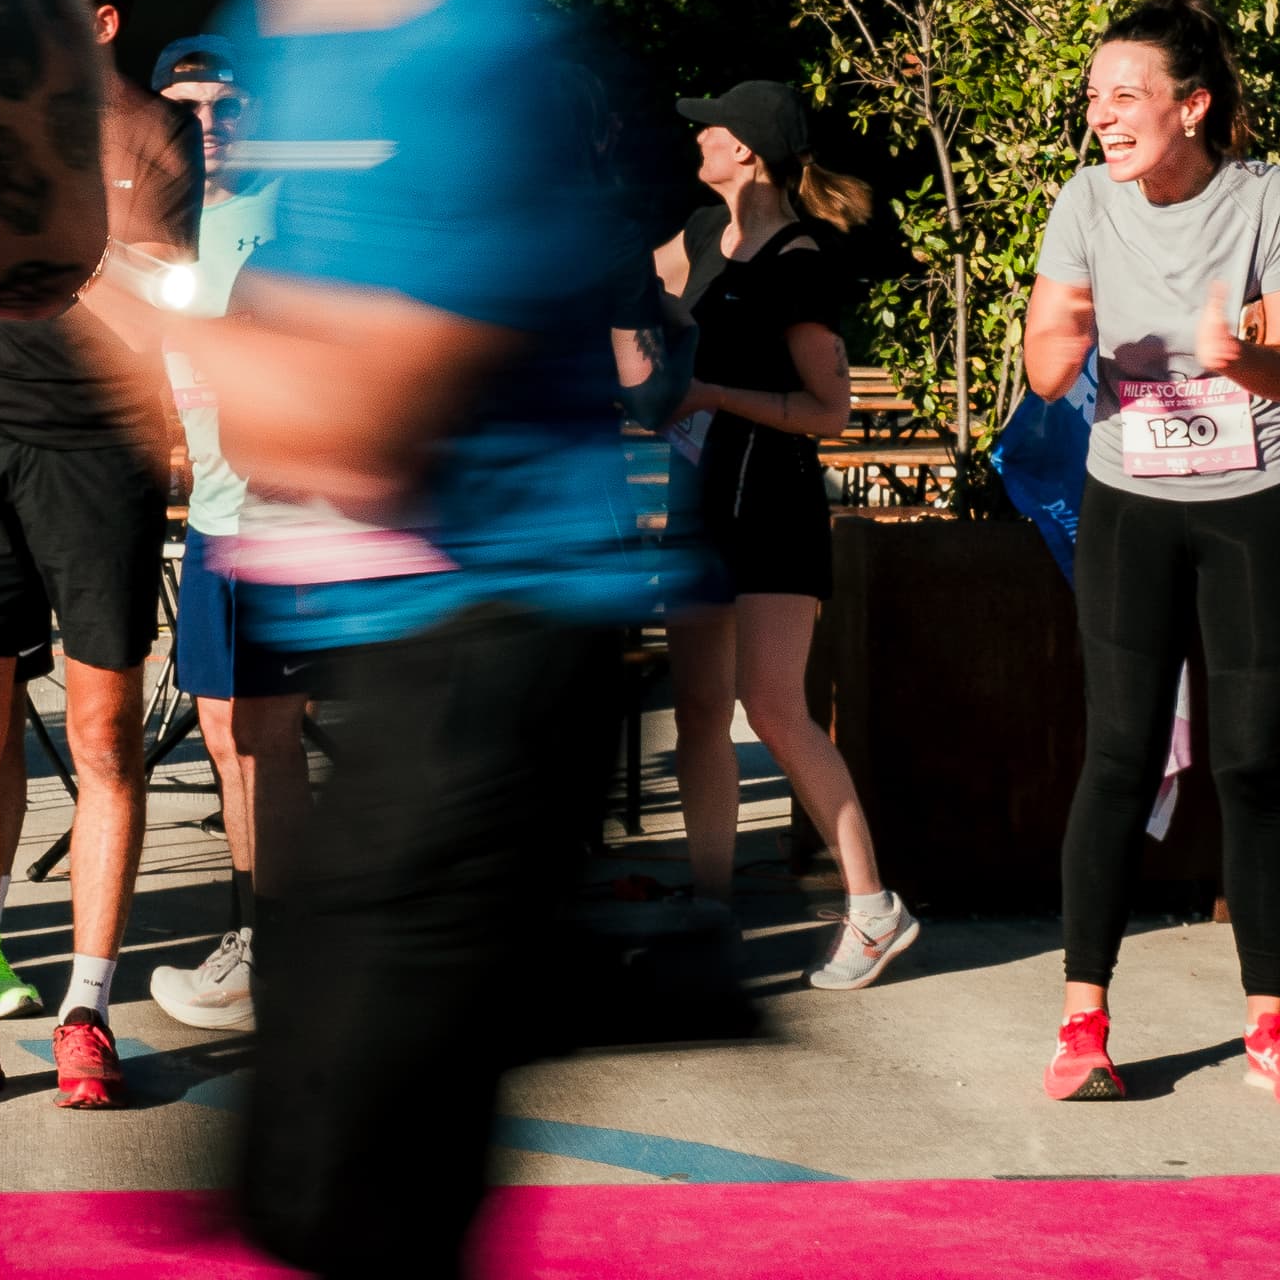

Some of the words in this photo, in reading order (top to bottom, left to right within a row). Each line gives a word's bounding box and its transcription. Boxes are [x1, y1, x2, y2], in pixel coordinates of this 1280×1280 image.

[1123, 383, 1153, 398] MILES
[1156, 380, 1204, 398] SOCIAL
[1147, 414, 1218, 449] 120
[83, 978, 103, 988] RUN
